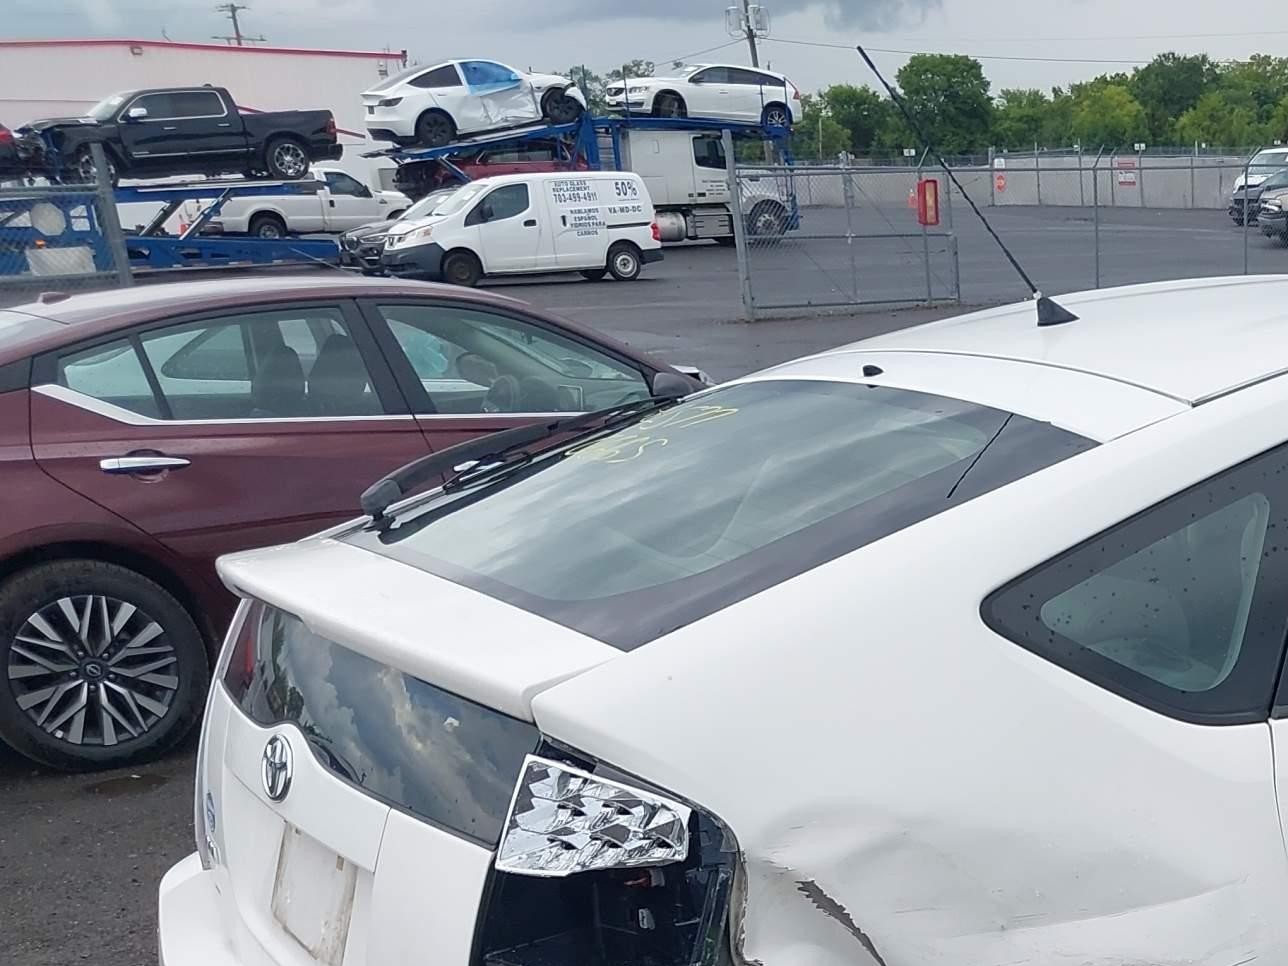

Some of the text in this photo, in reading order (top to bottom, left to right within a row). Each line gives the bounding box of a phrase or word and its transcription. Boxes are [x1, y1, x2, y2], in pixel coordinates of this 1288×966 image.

[614, 181, 638, 197] 50%
[553, 192, 598, 204] 703-499-4911
[608, 205, 642, 214] VA-MD-DC
